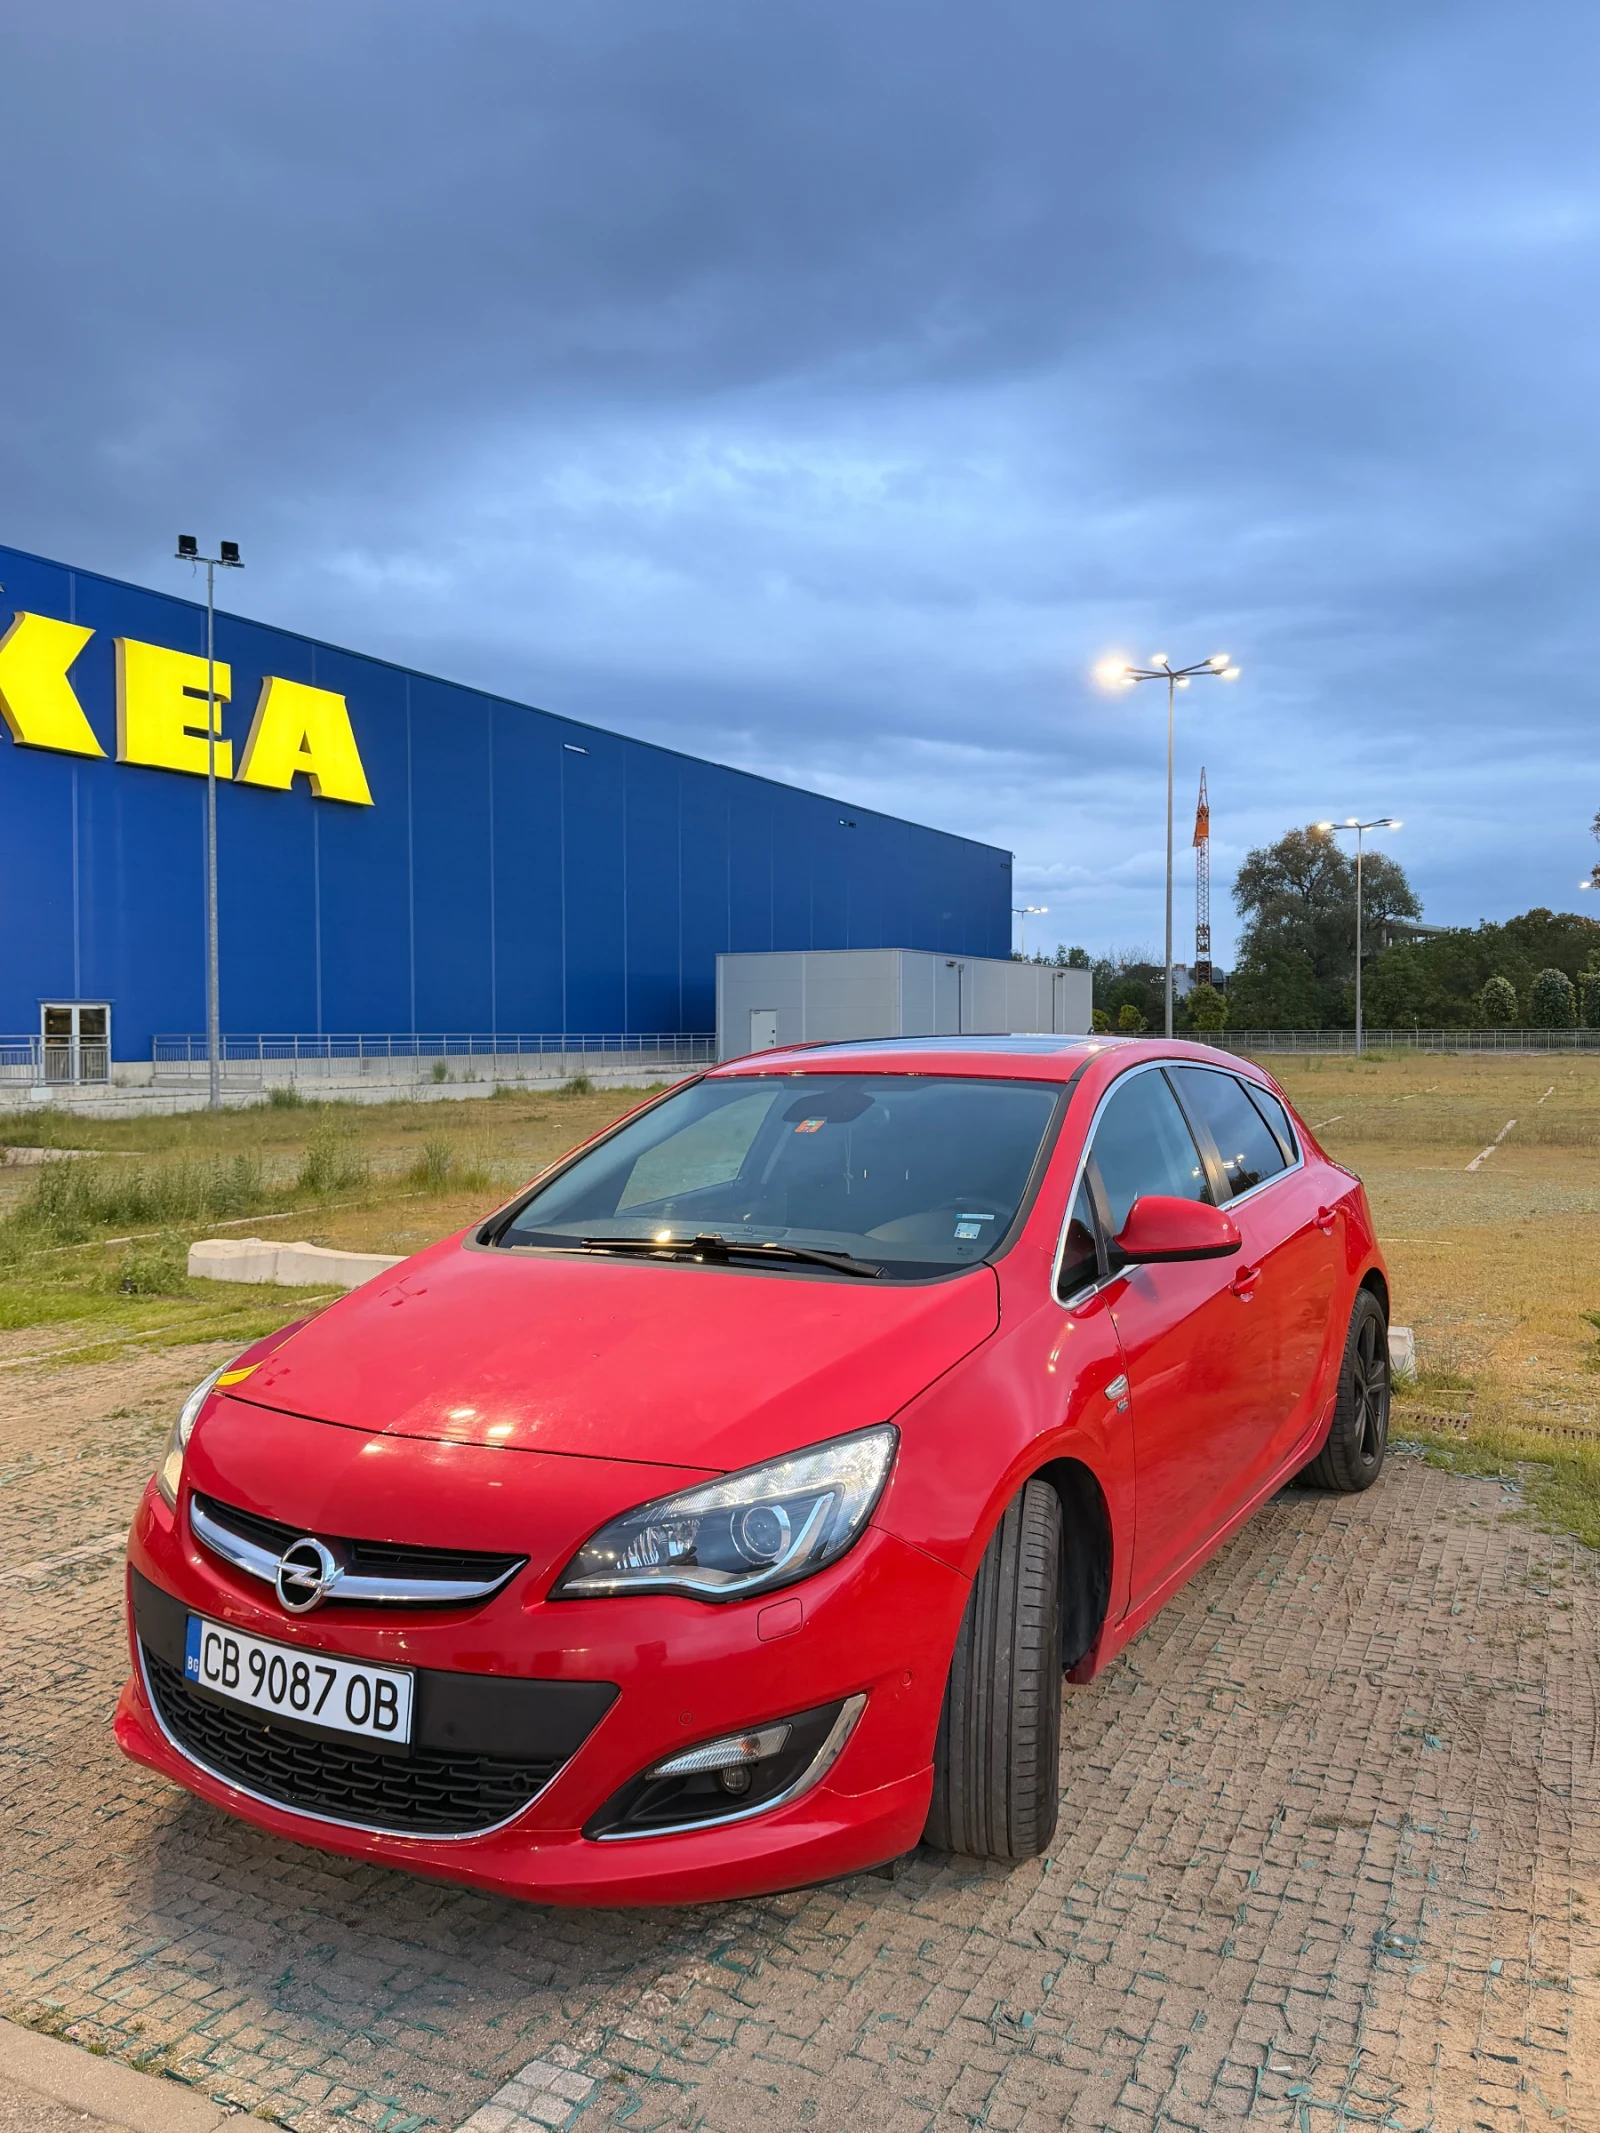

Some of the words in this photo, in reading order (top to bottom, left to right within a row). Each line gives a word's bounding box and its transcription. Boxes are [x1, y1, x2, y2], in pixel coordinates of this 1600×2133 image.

[187, 1656, 199, 1673] BG
[204, 1632, 240, 1689] CB
[249, 1648, 337, 1716] 9087
[345, 1674, 399, 1732] OB
